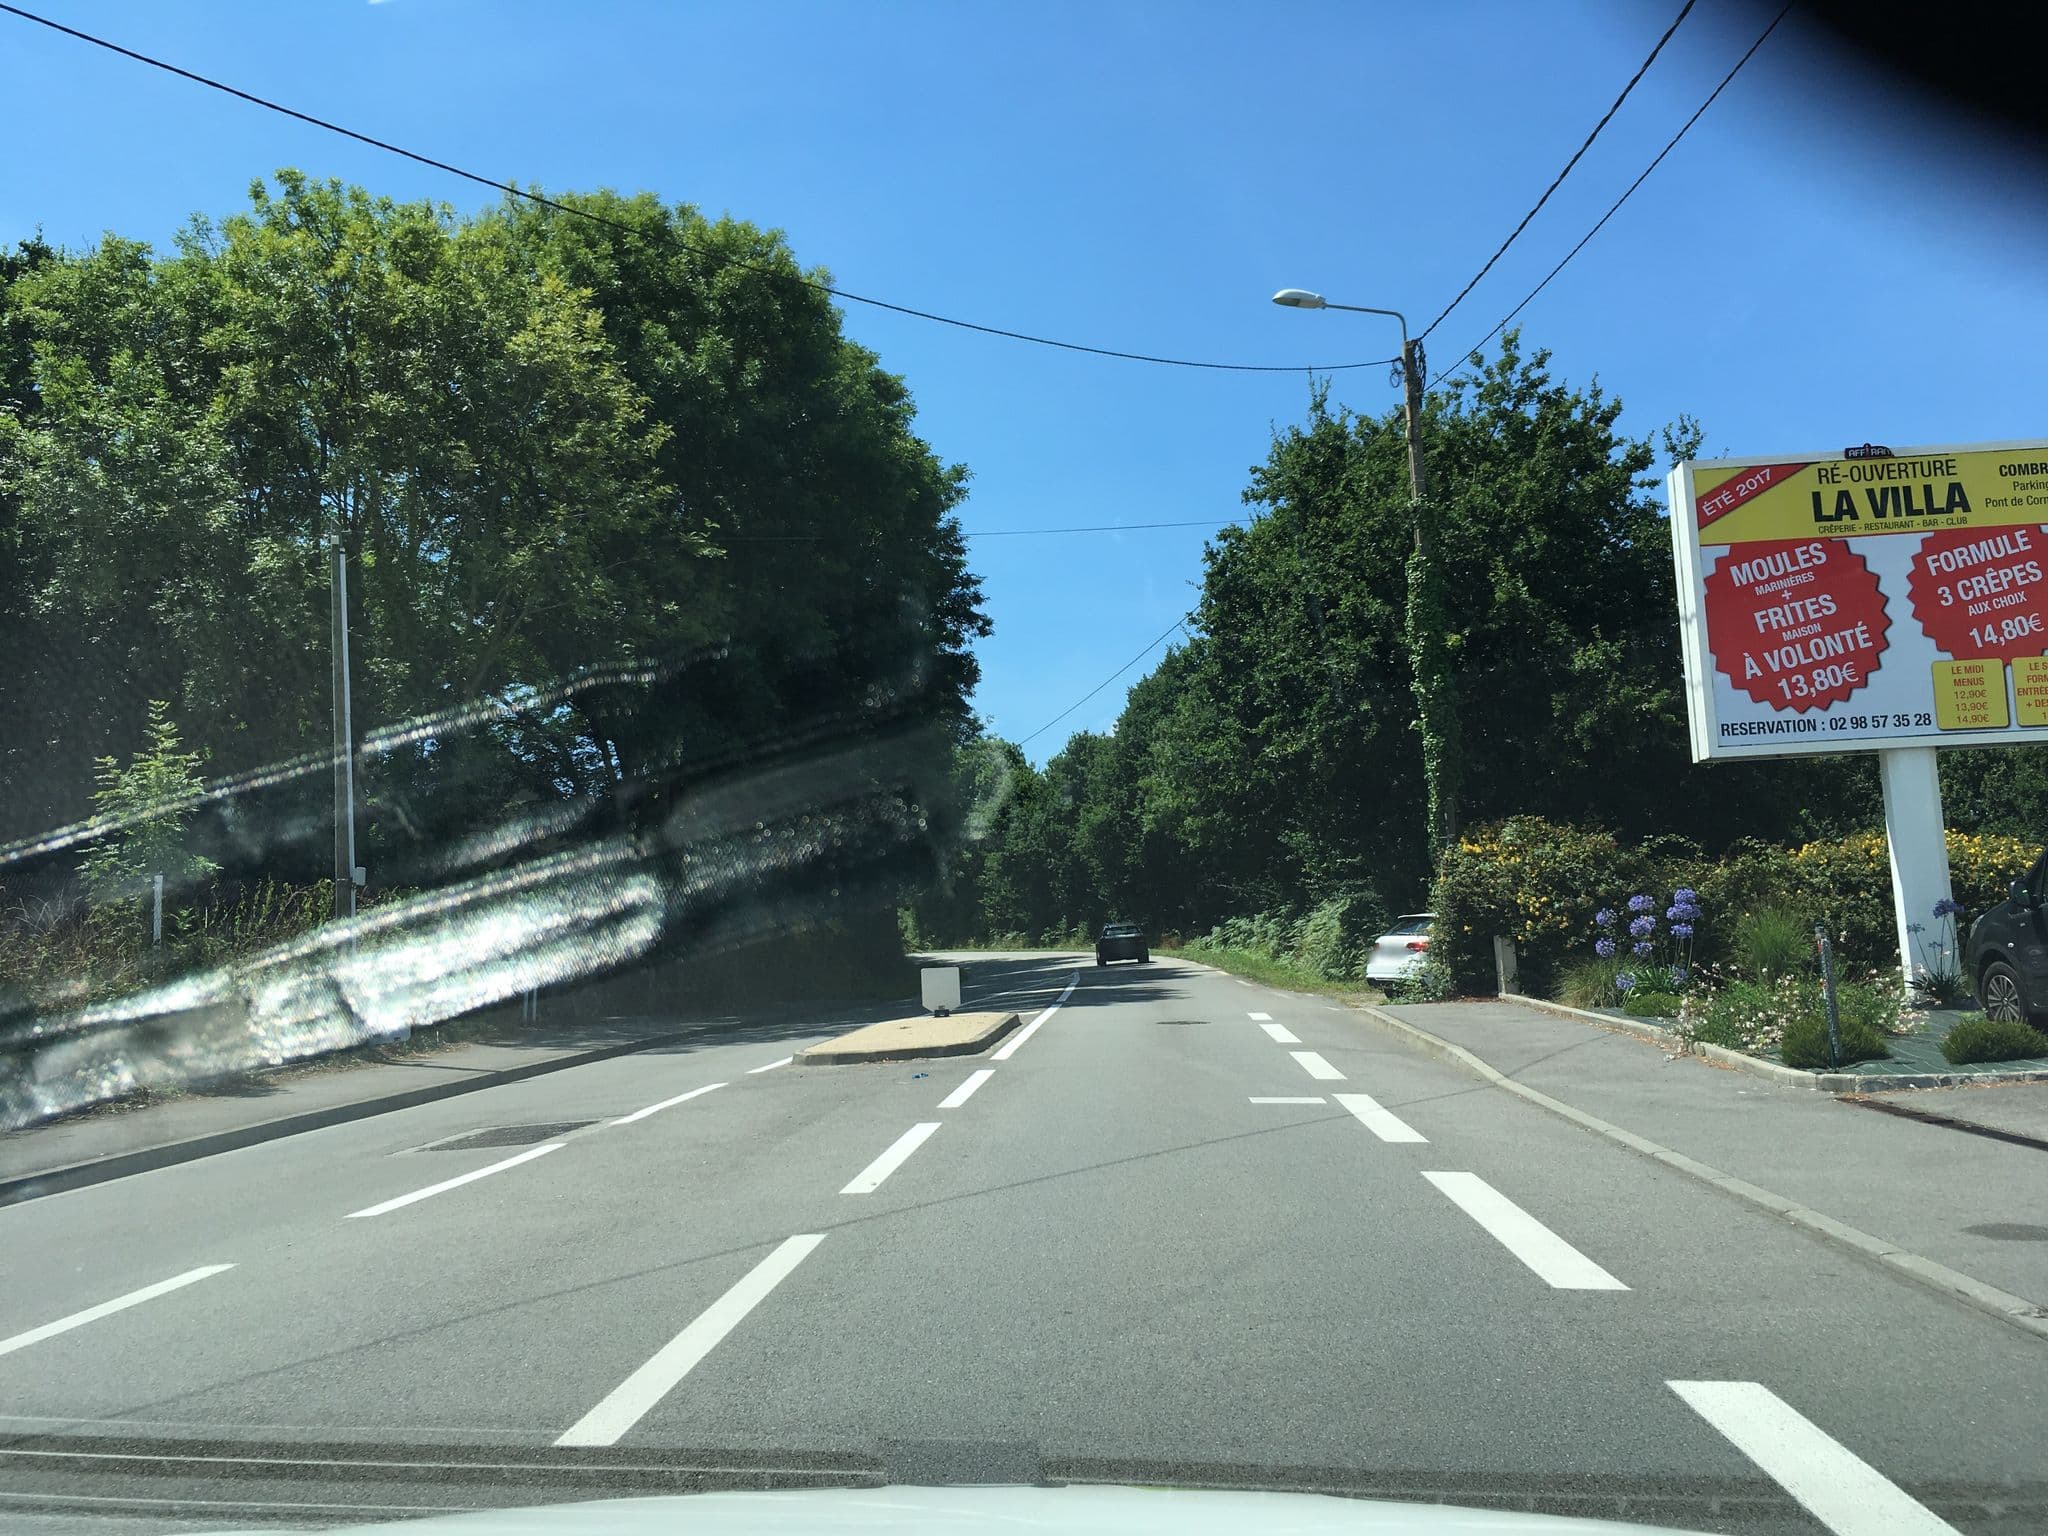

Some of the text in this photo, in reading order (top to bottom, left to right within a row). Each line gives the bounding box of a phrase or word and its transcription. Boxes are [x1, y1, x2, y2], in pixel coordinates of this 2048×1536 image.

[1817, 459, 1958, 485] RÉ-OUVERTURE
[1998, 462, 2048, 477] COMBR
[1702, 468, 1772, 516] ÉTÉ 2017
[1811, 482, 1972, 522] LA VILLA
[1984, 496, 2009, 508] Pont
[2010, 496, 2024, 507] de
[1818, 523, 1857, 534] CRÊPERIE
[1864, 519, 1914, 531] RESTAURANT
[1922, 518, 1938, 527] BAR
[1946, 516, 1968, 526] CLUB
[1729, 542, 1827, 587] MOULES
[1926, 529, 2032, 576] FORMULE
[1755, 571, 1815, 596] MARINIÈRES
[1781, 589, 1792, 600] +
[1937, 560, 2043, 607] 3 CRÊPES
[1753, 593, 1838, 634] FRITES
[1968, 590, 2028, 616] AUX CHOIX
[1781, 622, 1822, 642] MAISON
[1969, 612, 2045, 648] 14,80€
[1743, 621, 1874, 680] À VOLONTÉ
[1951, 664, 1984, 675] LE MIDI
[2029, 662, 2039, 671] LE
[1777, 661, 1859, 700] 13,80€
[1953, 677, 1985, 687] MENUS
[1954, 689, 1988, 700] 12,90€
[1720, 718, 1817, 737] RESERVATION
[1829, 716, 1847, 731] 02
[1850, 715, 1867, 730] 98
[1871, 714, 1889, 729] 57
[1893, 713, 1910, 728] 35
[1914, 712, 1932, 726] 28
